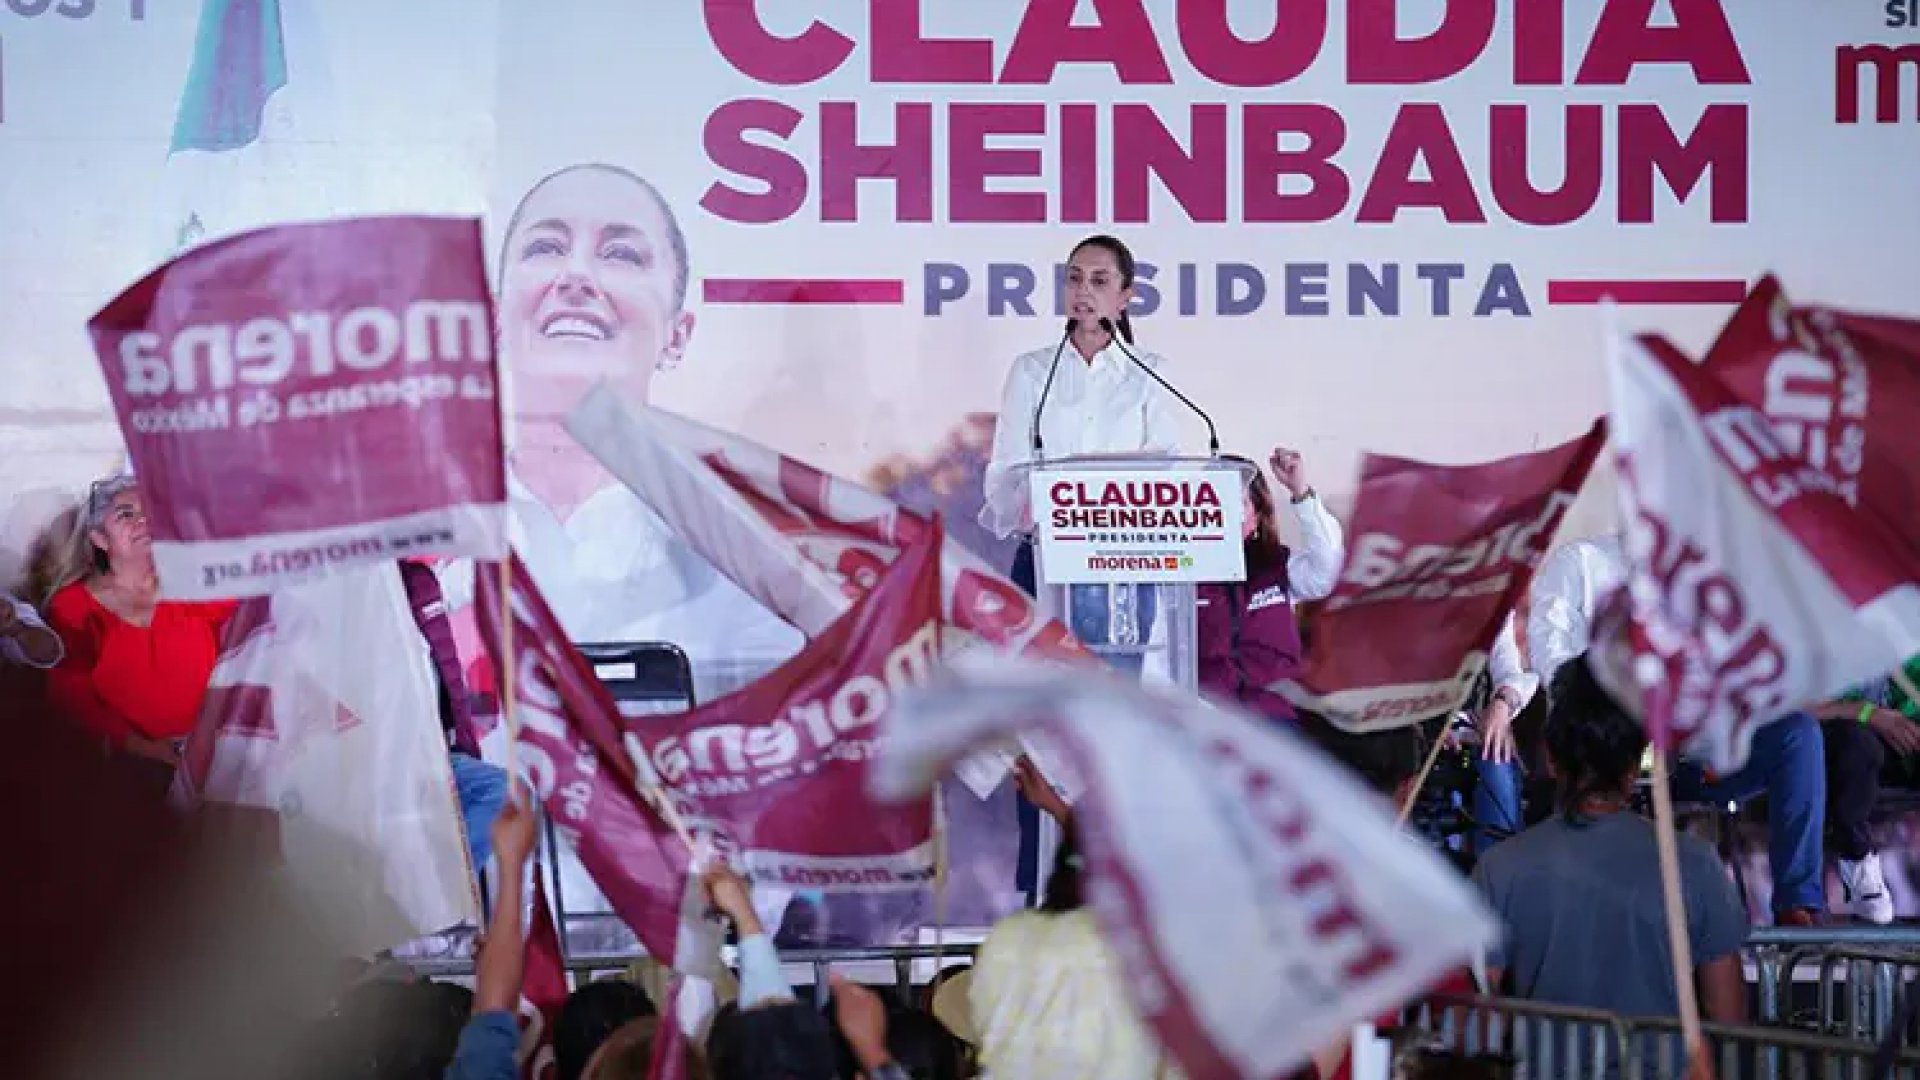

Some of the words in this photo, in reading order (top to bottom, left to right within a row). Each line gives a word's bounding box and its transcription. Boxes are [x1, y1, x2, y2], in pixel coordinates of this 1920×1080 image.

[704, 0, 1751, 86] CLAUDIA
[699, 98, 1748, 225] SHEINBAUM
[924, 263, 1532, 316] PRSIDENTA
[1051, 481, 1220, 507] CLAUDIA
[1052, 509, 1224, 527] SHEINBAUM
[1087, 556, 1162, 571] morena
